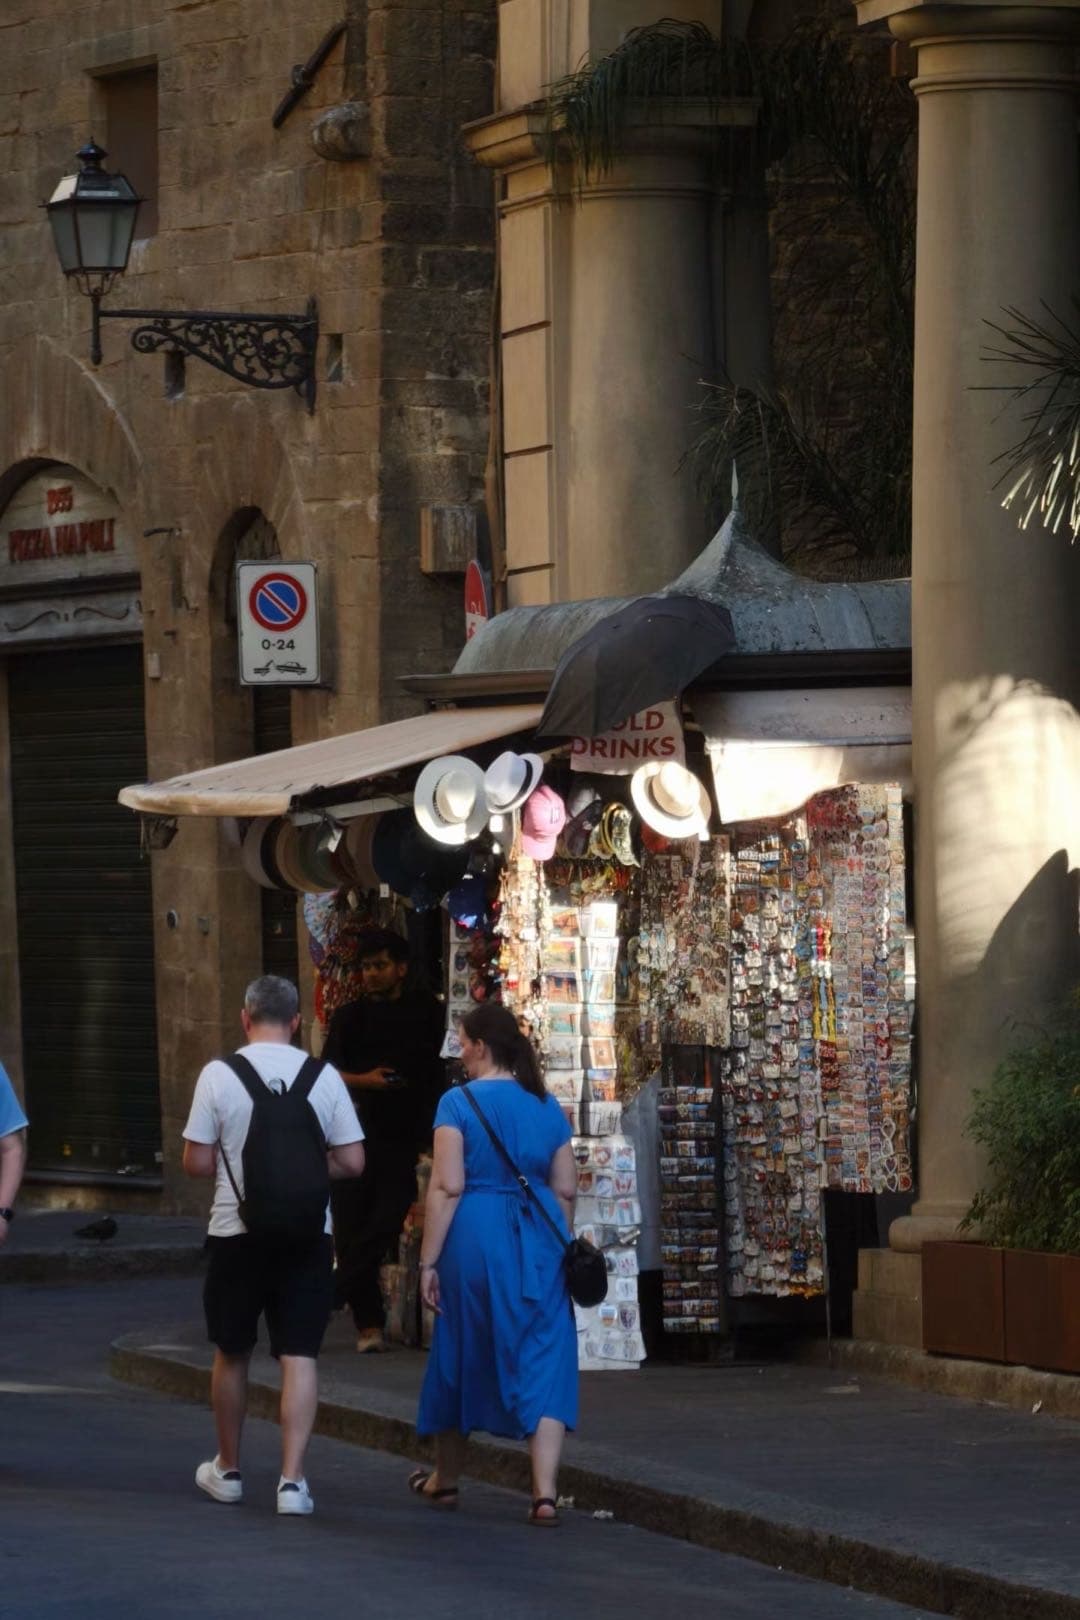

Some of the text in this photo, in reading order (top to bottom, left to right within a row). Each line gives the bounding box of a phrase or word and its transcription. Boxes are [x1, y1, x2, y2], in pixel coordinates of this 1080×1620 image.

[8, 518, 115, 562] PIZZA NAPOLI
[261, 639, 296, 650] 0-24
[571, 736, 677, 759] DRINKS
